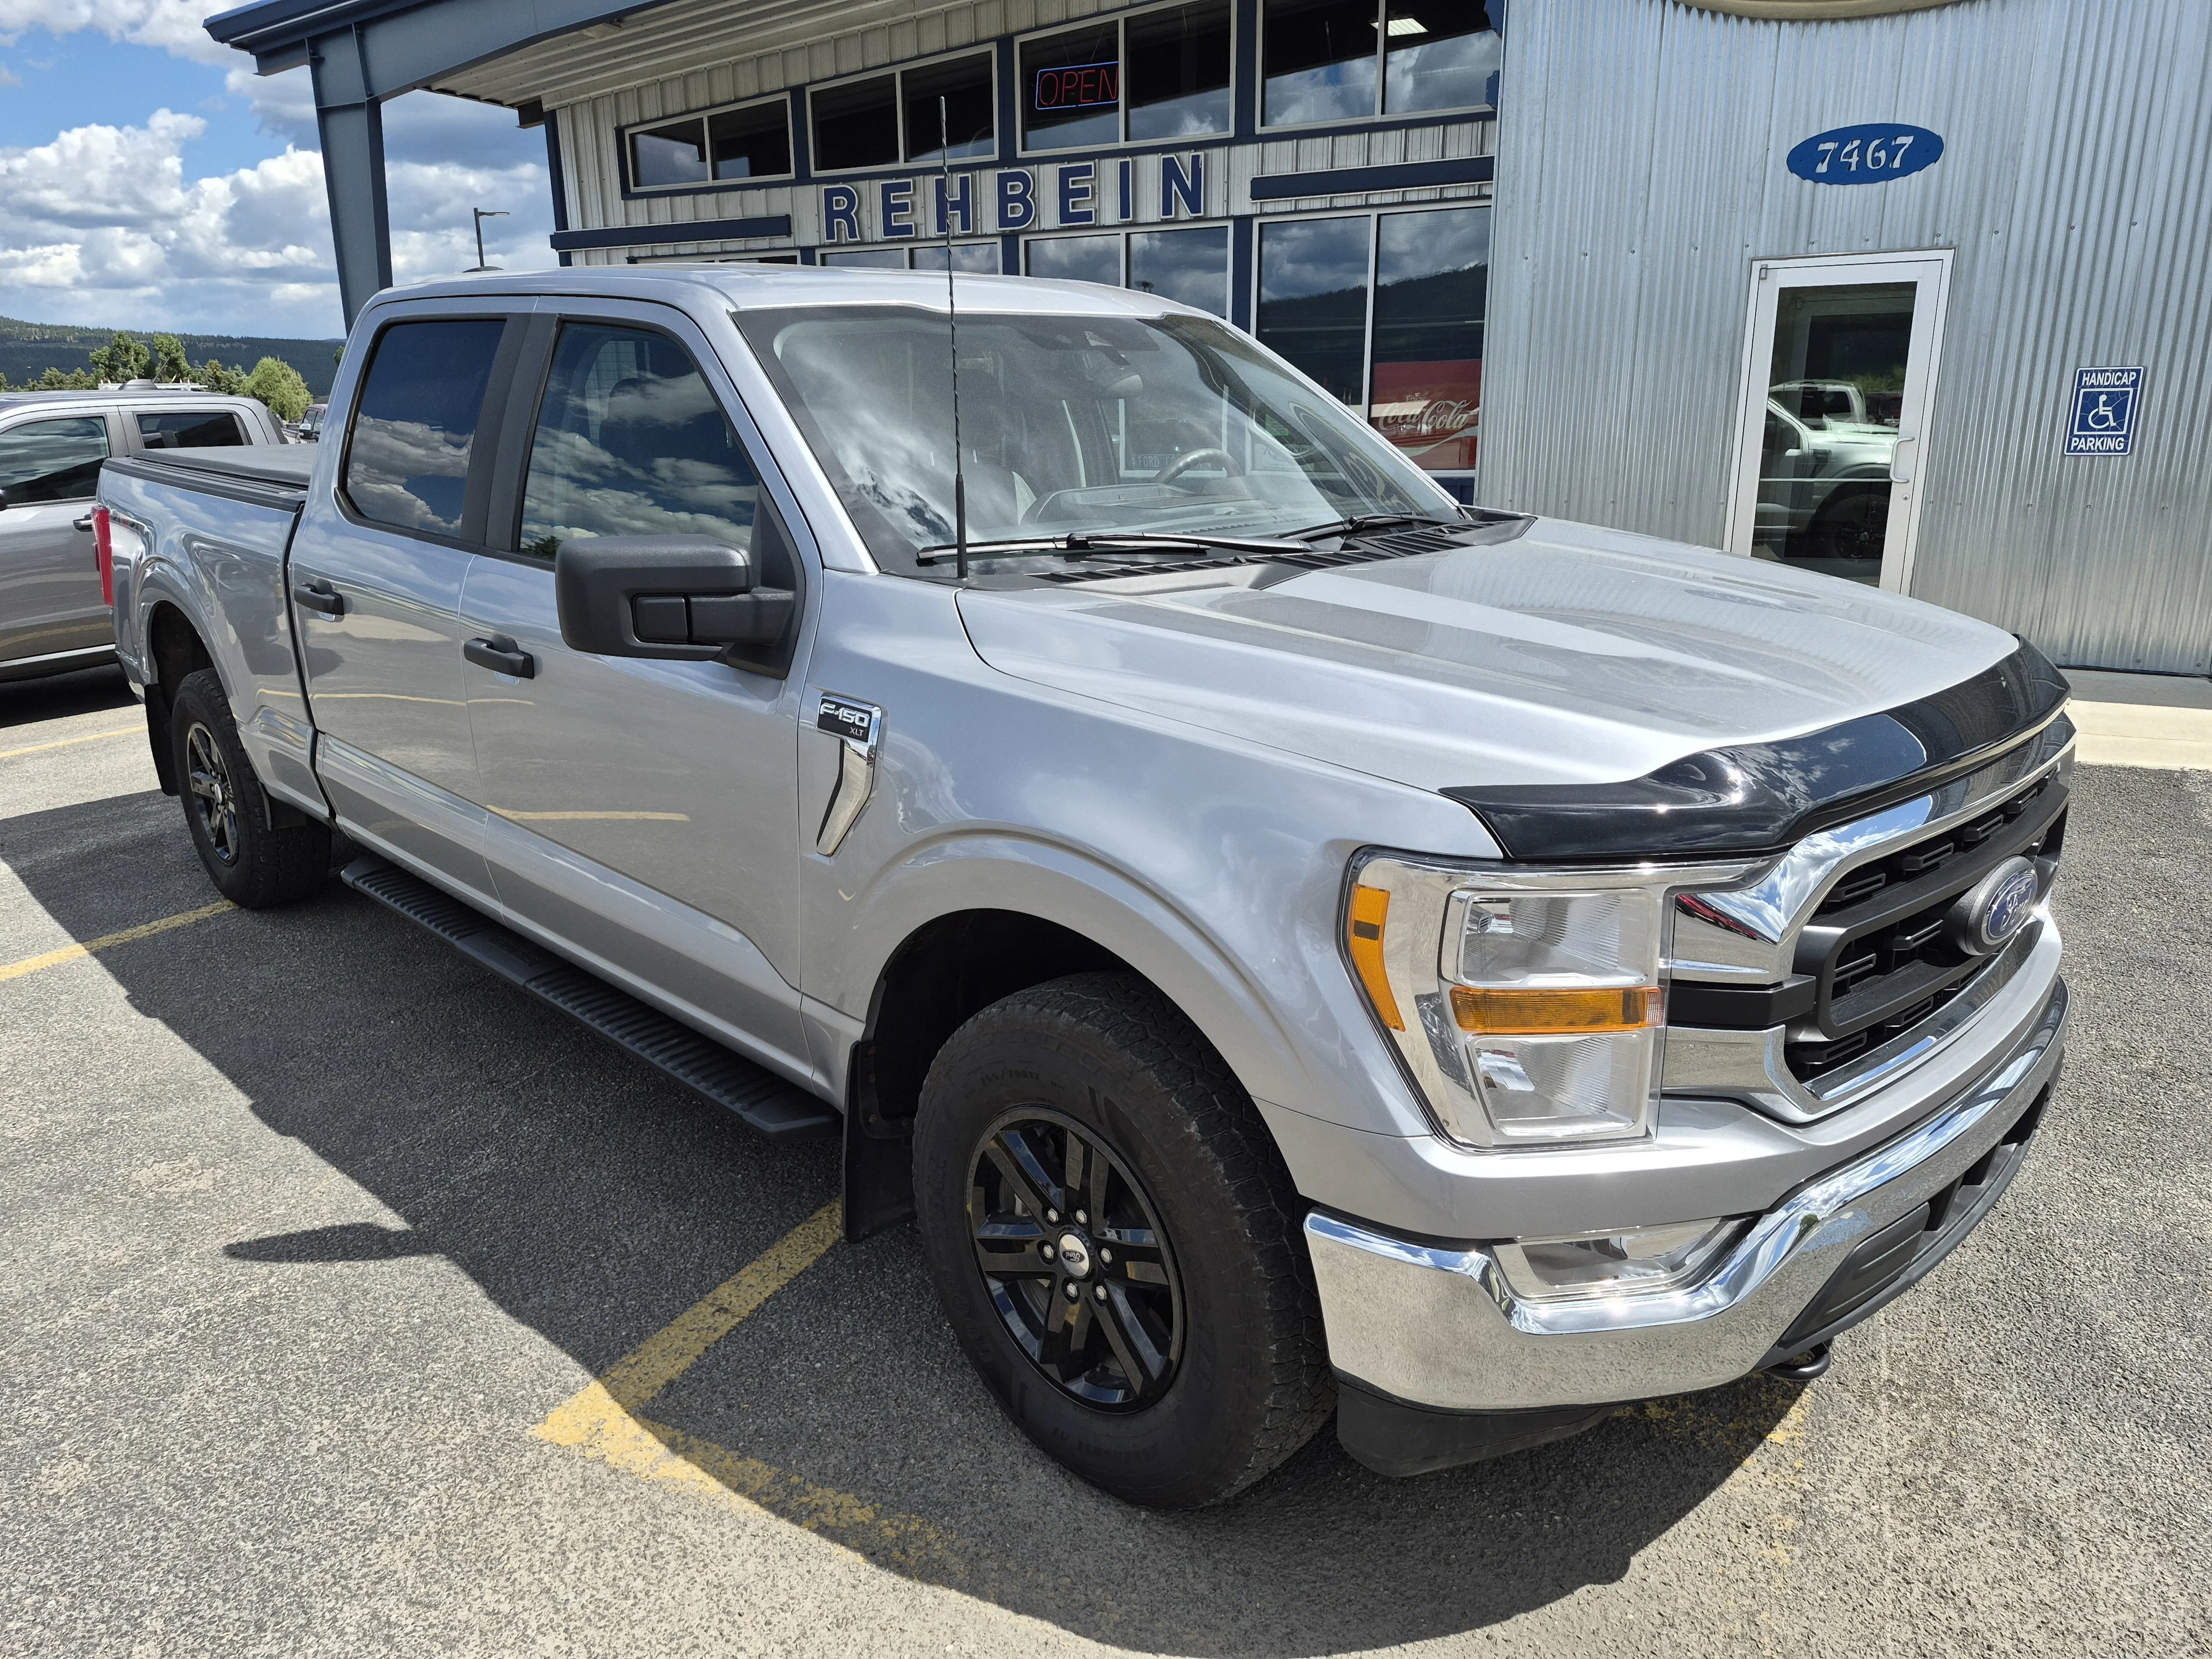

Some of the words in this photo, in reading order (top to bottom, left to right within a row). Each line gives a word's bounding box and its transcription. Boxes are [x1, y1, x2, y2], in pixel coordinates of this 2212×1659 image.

[1039, 66, 1119, 106] OPEN
[1815, 135, 1914, 173] 7467
[822, 150, 1205, 243] REHBEIN
[2081, 372, 2137, 386] HANDICAP
[2070, 437, 2125, 451] PARKING
[819, 702, 870, 728] F-150
[849, 726, 864, 737] XLT
[2000, 878, 2033, 932] Ford
[1065, 1251, 1081, 1262] Ford
